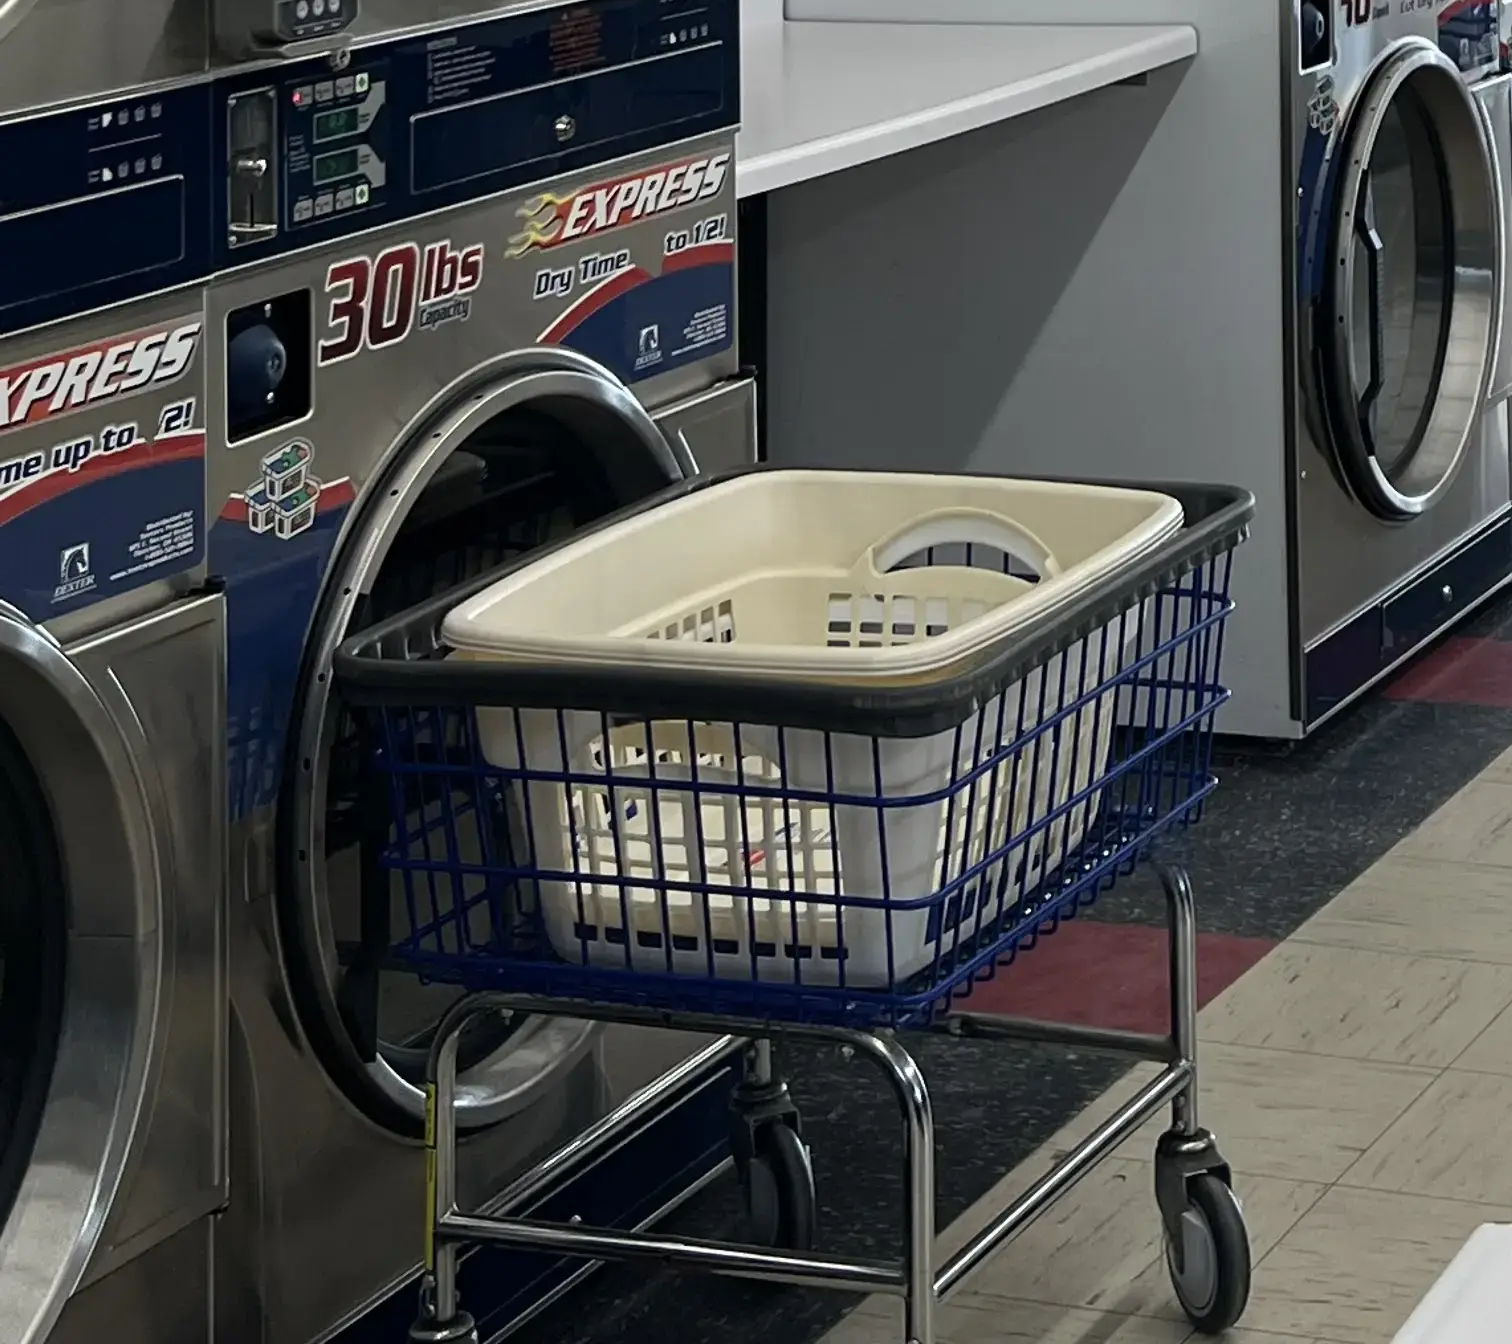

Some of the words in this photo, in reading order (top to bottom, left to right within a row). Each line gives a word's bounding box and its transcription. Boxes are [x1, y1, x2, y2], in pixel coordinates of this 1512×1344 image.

[562, 153, 731, 241] EXPRESS
[666, 231, 689, 252] to
[535, 269, 573, 298] Dry
[580, 252, 628, 279] Time
[319, 241, 419, 367] 30
[420, 240, 485, 306] lbs
[419, 298, 470, 329] Capacity
[53, 439, 91, 471] up
[102, 424, 135, 450] to
[54, 574, 95, 597] DEXTER
